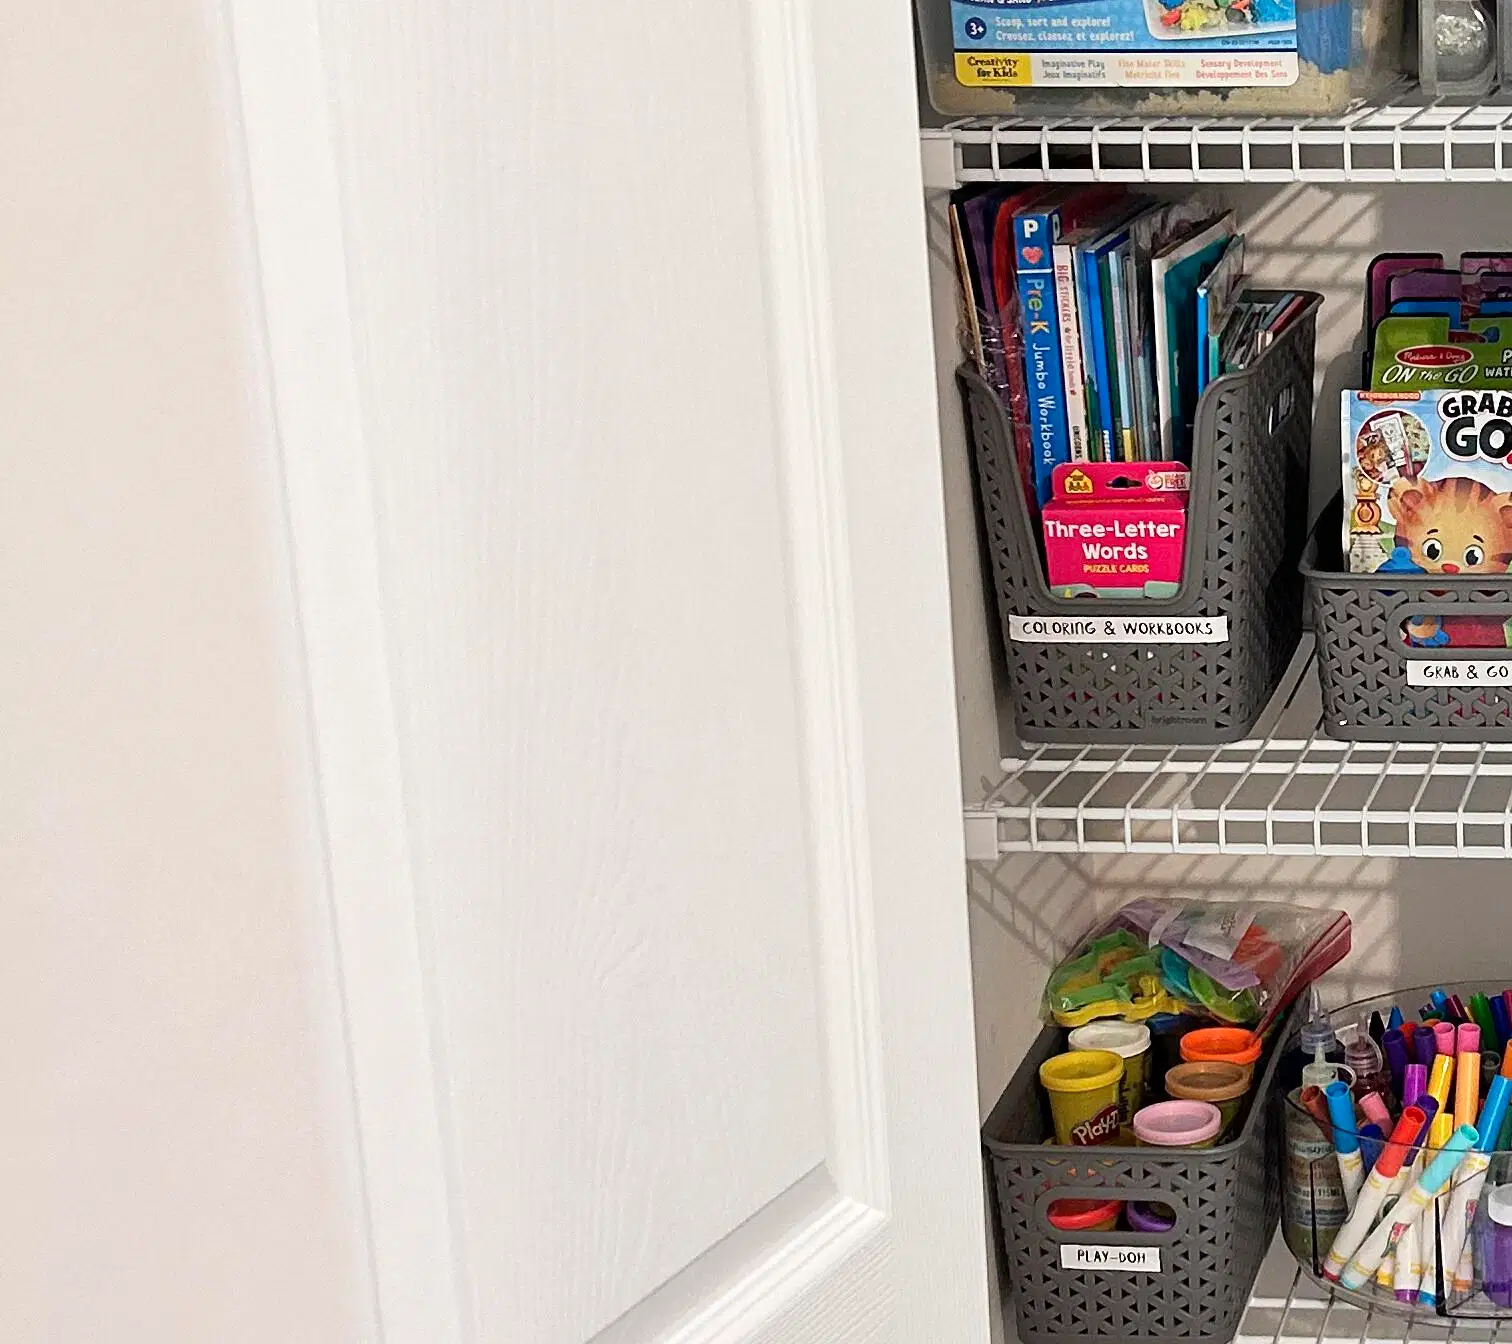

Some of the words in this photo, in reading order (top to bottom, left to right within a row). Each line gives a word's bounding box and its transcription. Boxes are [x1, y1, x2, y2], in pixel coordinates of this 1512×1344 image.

[969, 22, 984, 36] 3+
[1051, 17, 1068, 27] and
[1076, 31, 1086, 41] et
[968, 56, 1018, 67] Creativity
[1042, 60, 1086, 69] Imaginative
[1088, 60, 1105, 69] Play
[1200, 59, 1231, 69] Sensory
[1234, 59, 1282, 69] Development
[977, 67, 991, 78] for
[993, 66, 1018, 78] Kids
[1043, 70, 1060, 79] Jeux
[1255, 70, 1268, 78] Des
[1271, 70, 1288, 78] Sens
[1023, 219, 1039, 238] P
[1057, 265, 1069, 282] BIG
[1026, 278, 1049, 334] Pre-K
[1032, 343, 1051, 390] Jumbo
[1382, 365, 1413, 384] ON
[1419, 369, 1442, 381] the
[1444, 364, 1479, 385] GO
[1037, 395, 1056, 466] Workbook
[1045, 520, 1180, 538] Three-Letter
[1081, 542, 1148, 560] Words
[1083, 564, 1117, 574] PUZZLE
[1119, 564, 1150, 574] CARDS
[1022, 621, 1096, 635] COLORING
[1104, 620, 1116, 636] &
[1123, 621, 1213, 636] WORKBOOKS
[1424, 665, 1459, 679] GRAB
[1467, 665, 1479, 679] &
[1486, 665, 1508, 677] GO
[1077, 1250, 1145, 1263] PLAY-DOH
